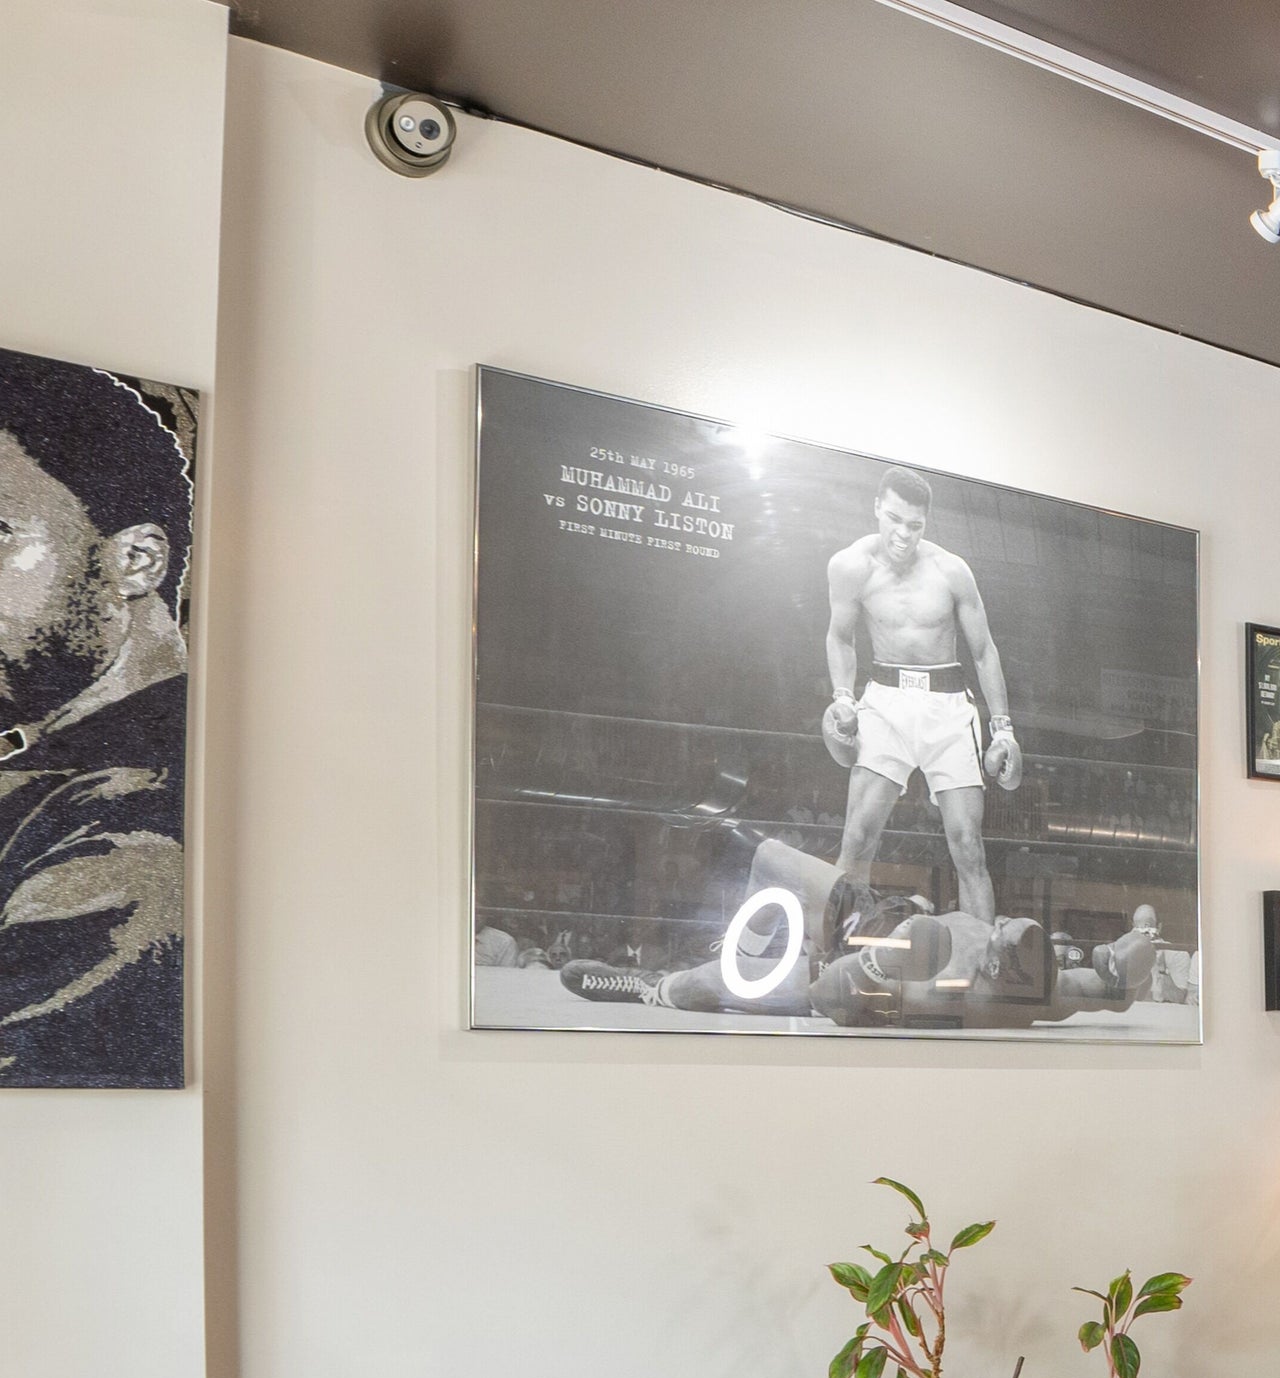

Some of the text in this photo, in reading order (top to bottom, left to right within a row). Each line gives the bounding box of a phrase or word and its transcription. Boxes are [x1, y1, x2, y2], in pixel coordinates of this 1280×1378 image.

[590, 447, 695, 479] 25th MAY 1965
[560, 465, 721, 513] MUHAMMAD ALI
[543, 494, 735, 541] vs SONNY LISTON
[558, 520, 720, 559] FIRST MINUTE FIRST ROUND
